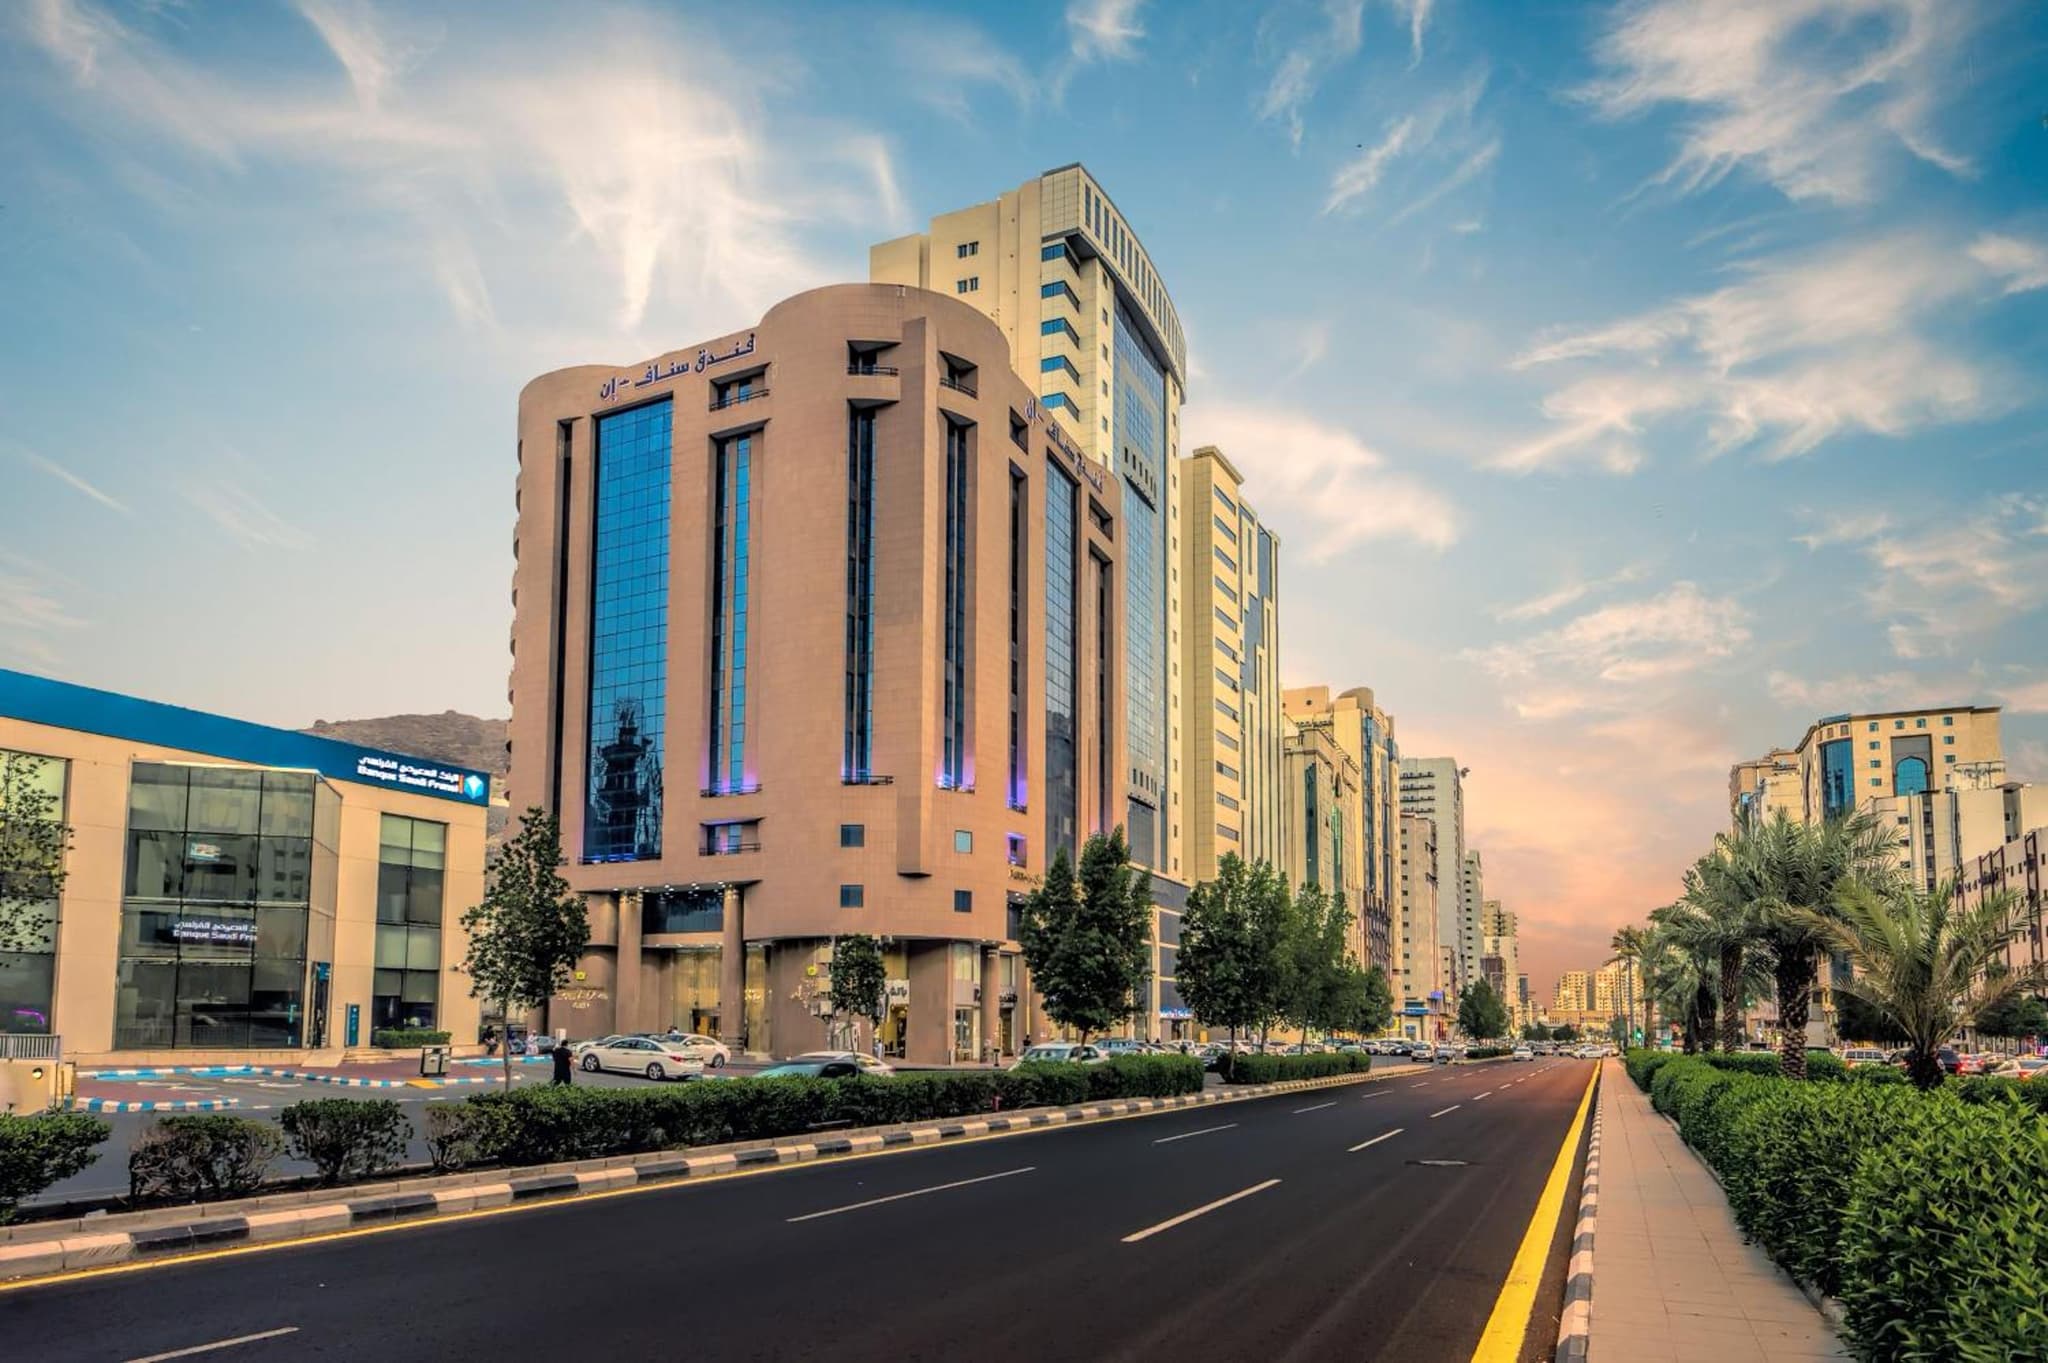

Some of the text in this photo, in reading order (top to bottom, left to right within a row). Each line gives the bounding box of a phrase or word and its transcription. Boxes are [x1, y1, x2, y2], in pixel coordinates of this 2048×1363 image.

[694, 333, 757, 374] فندق
[635, 361, 690, 388] سناف
[357, 765, 397, 781] Banque
[398, 774, 428, 787] Saudi
[172, 929, 210, 939] Banque
